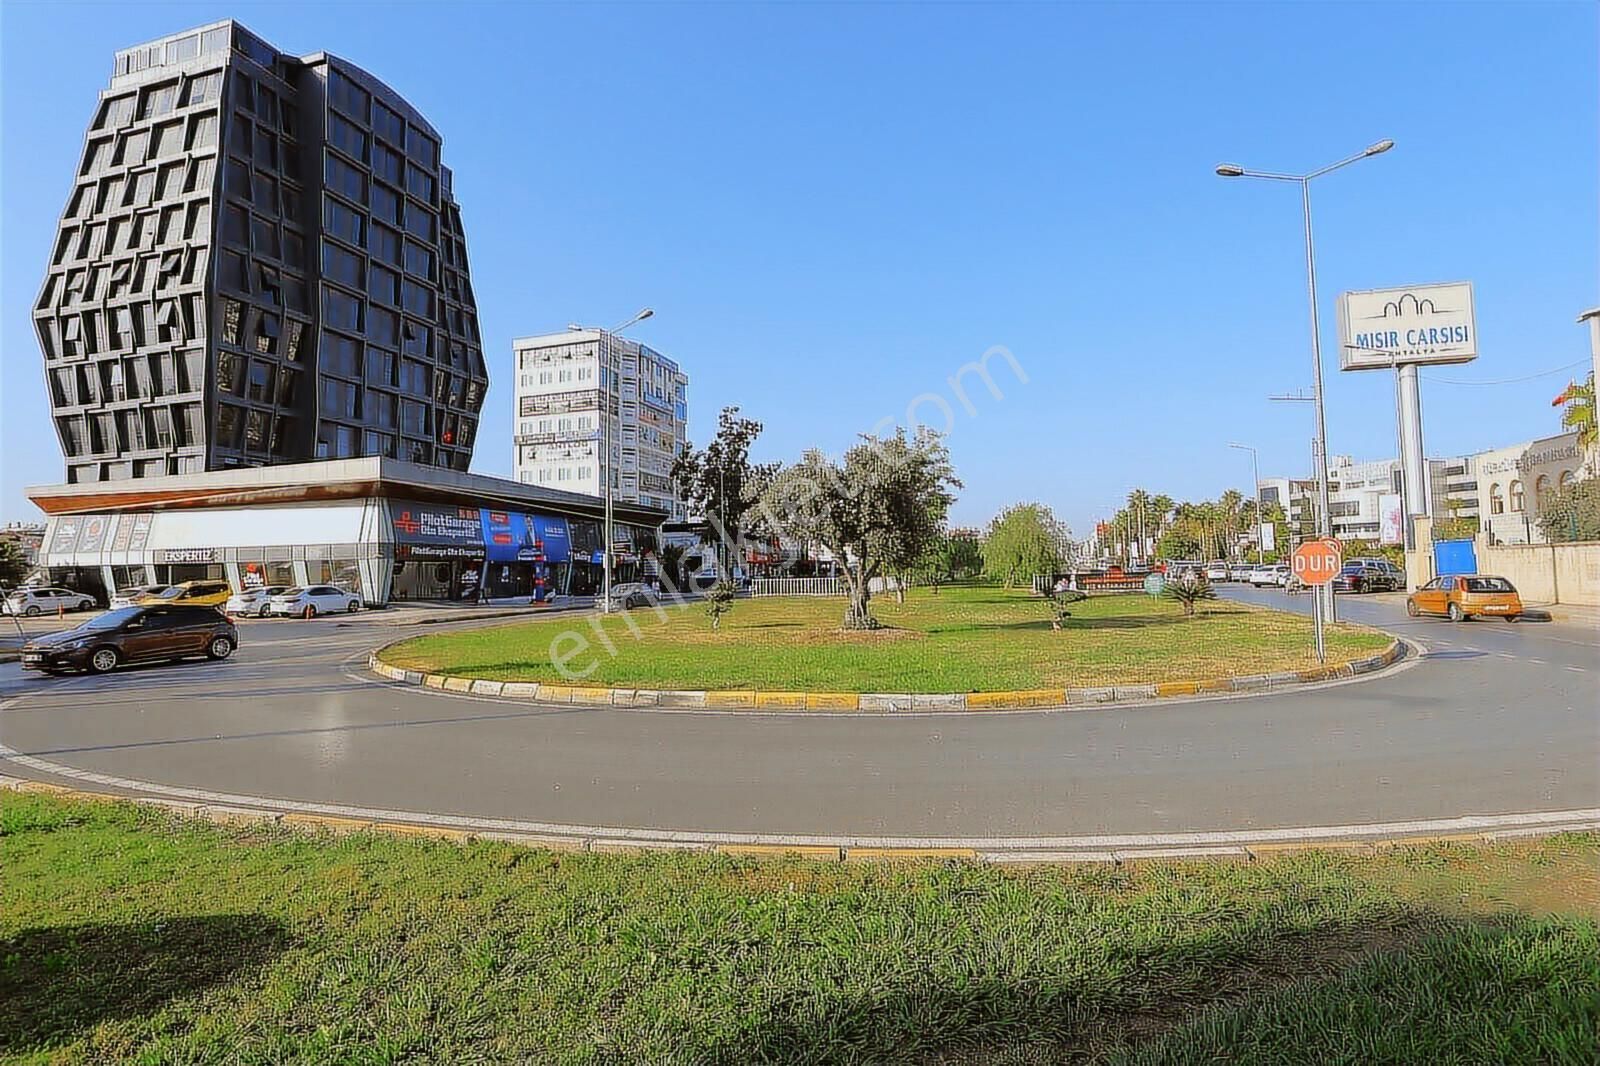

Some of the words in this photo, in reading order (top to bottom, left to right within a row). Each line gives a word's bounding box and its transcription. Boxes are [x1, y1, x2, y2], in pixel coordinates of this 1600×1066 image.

[1356, 331, 1399, 349] MISIR
[420, 512, 481, 531] PilotGarage
[420, 525, 437, 535] Oto
[437, 526, 476, 539] Ekspertiz
[1295, 555, 1337, 572] DUR
